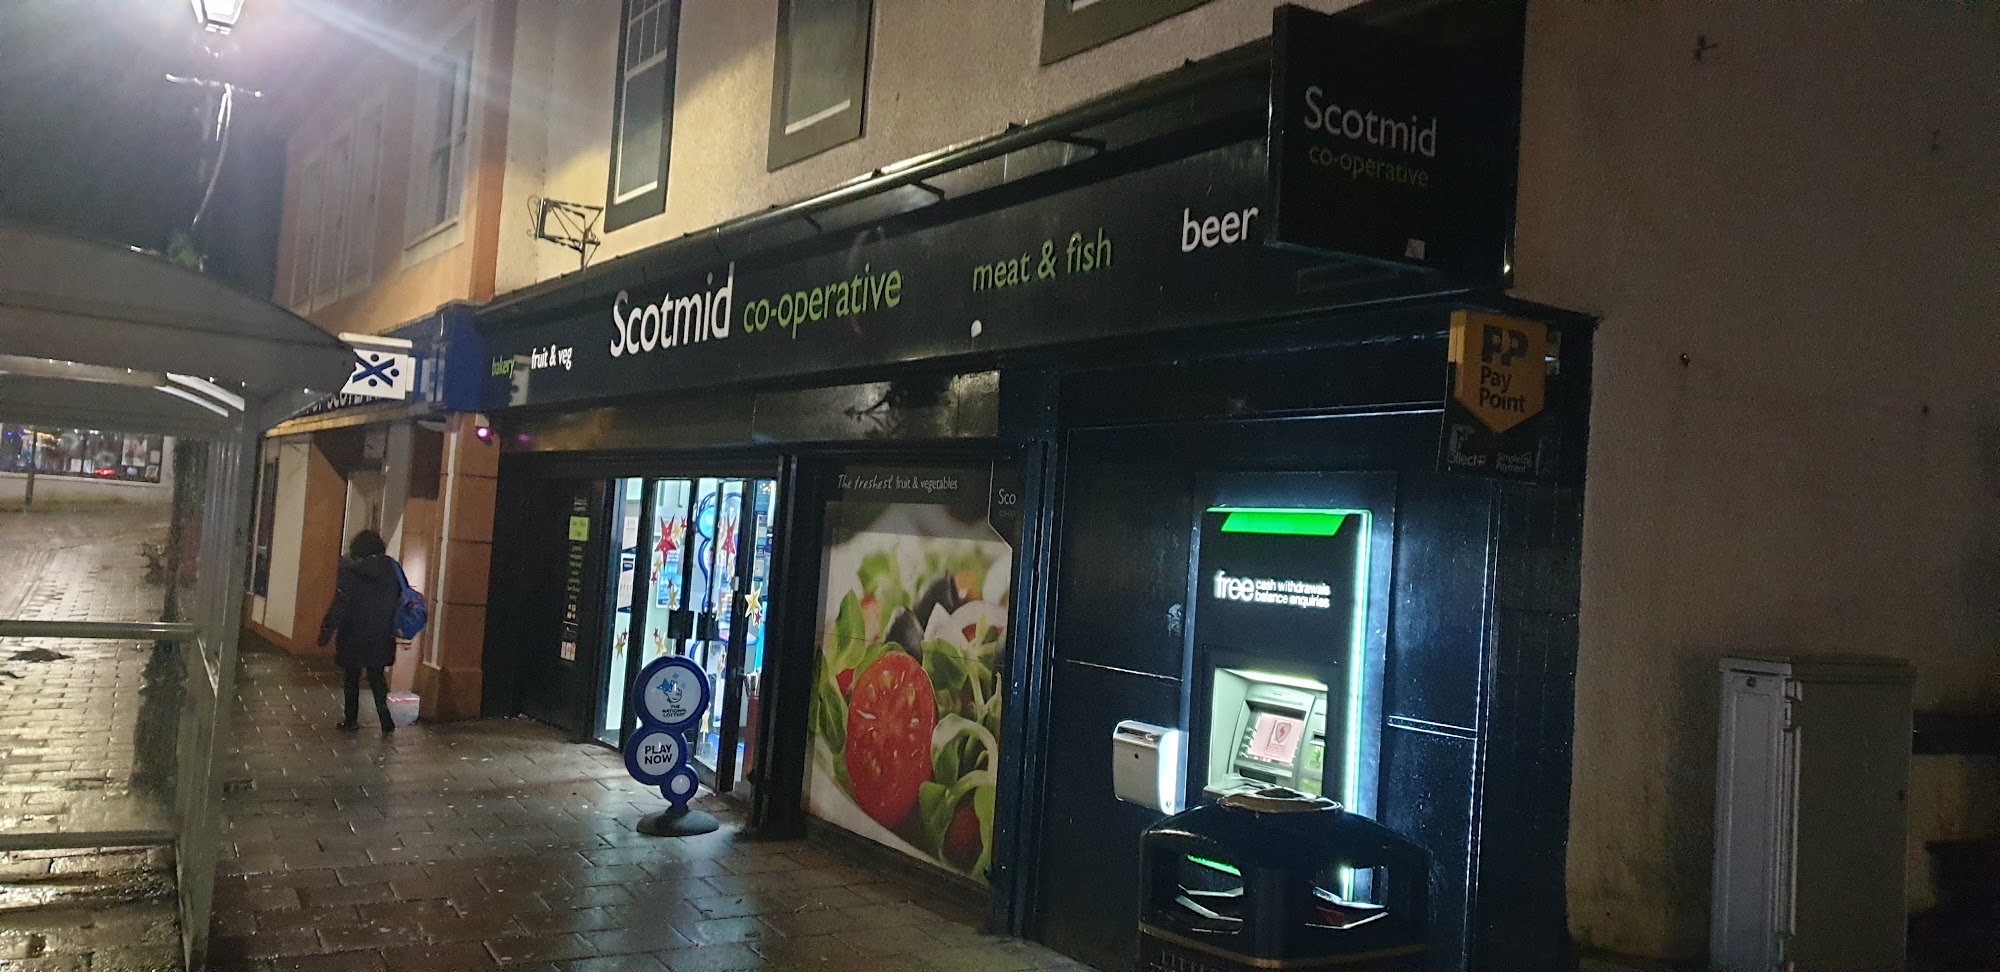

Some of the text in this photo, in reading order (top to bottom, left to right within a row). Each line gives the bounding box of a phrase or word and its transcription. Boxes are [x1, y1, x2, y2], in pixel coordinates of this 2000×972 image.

[1303, 85, 1438, 158] Scotmid
[1308, 146, 1430, 188] co-operative
[1181, 206, 1260, 253] beer
[972, 227, 1114, 292] meat & fish
[610, 260, 903, 358] Scotmid co-operative
[491, 354, 516, 379] bakery
[531, 344, 573, 371] fruit & veg
[1480, 365, 1513, 394] Pay
[1479, 387, 1527, 413] Point
[837, 474, 958, 493] The freshest fruit & vegetables
[1214, 569, 1331, 601] free cash withdrawals
[1255, 590, 1331, 608] balance enquiries
[645, 744, 672, 754] PLAY
[645, 753, 672, 764] NOW
